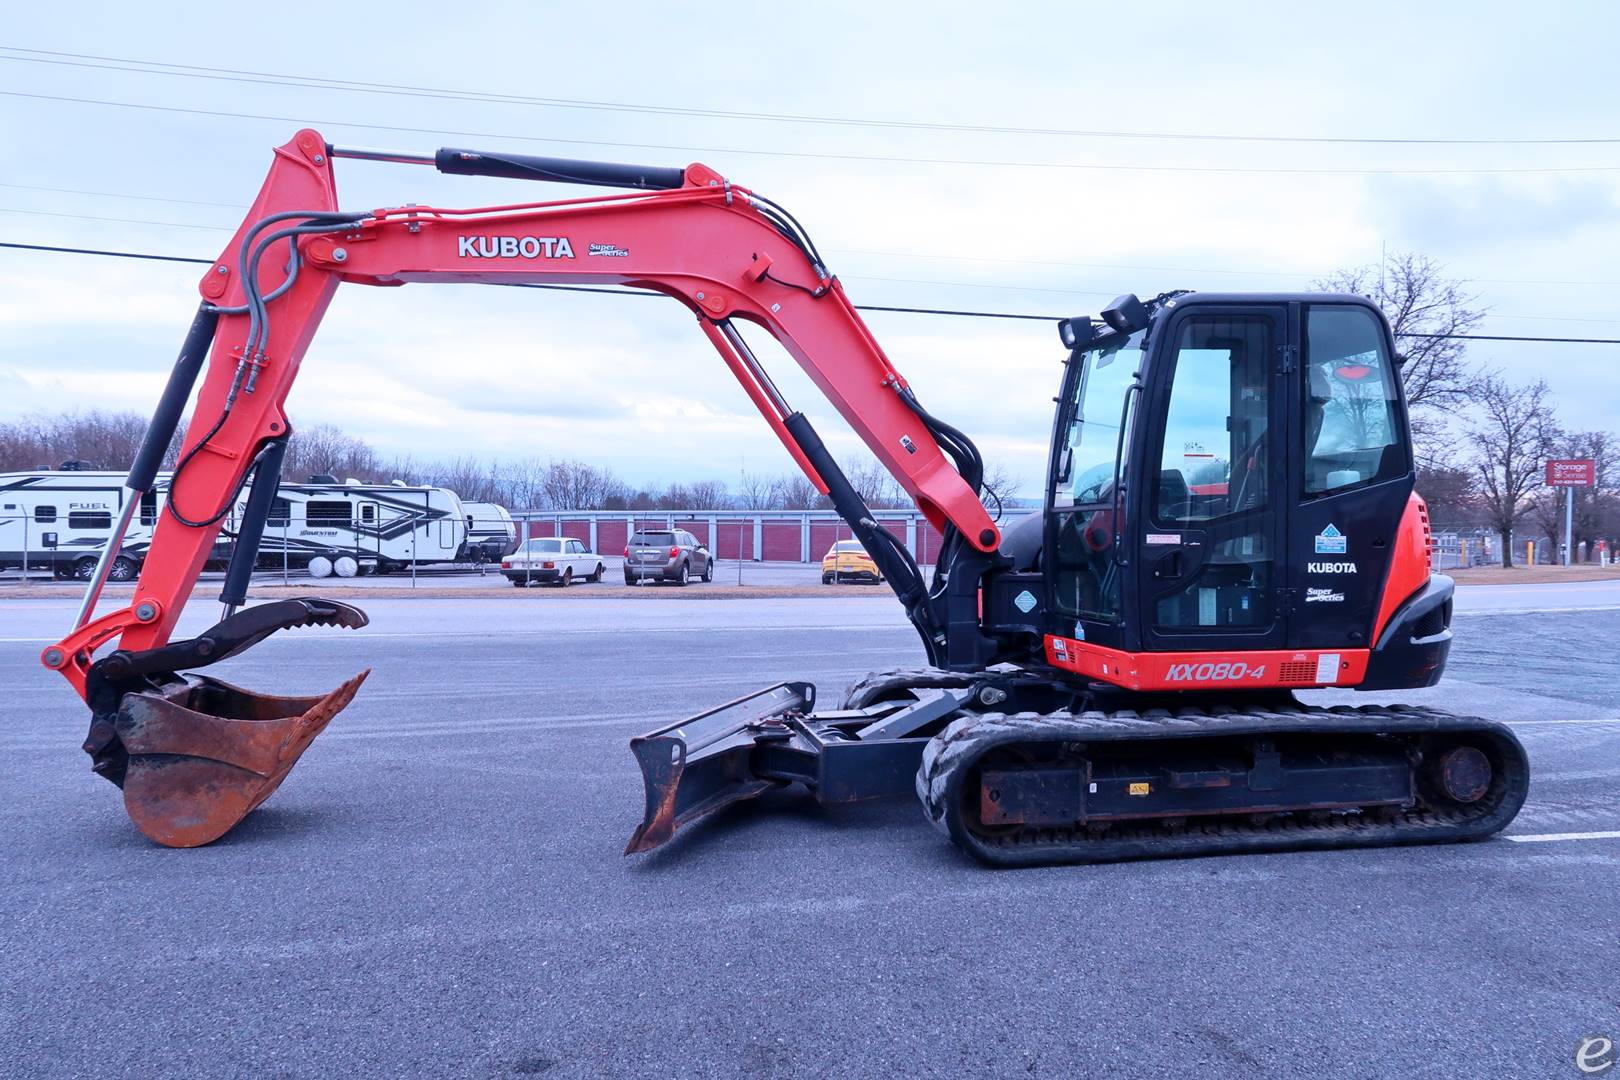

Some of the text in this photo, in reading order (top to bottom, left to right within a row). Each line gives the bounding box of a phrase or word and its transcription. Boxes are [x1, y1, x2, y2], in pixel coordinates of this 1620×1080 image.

[458, 236, 575, 259] KUBOTA
[589, 243, 616, 252] Super
[594, 249, 629, 257] Series
[1553, 462, 1588, 473] Storage
[69, 502, 110, 510] FUEL
[1307, 562, 1358, 574] KUBOTA
[1306, 587, 1333, 597] Super
[1310, 593, 1345, 602] Series
[1164, 662, 1267, 681] KX080-4
